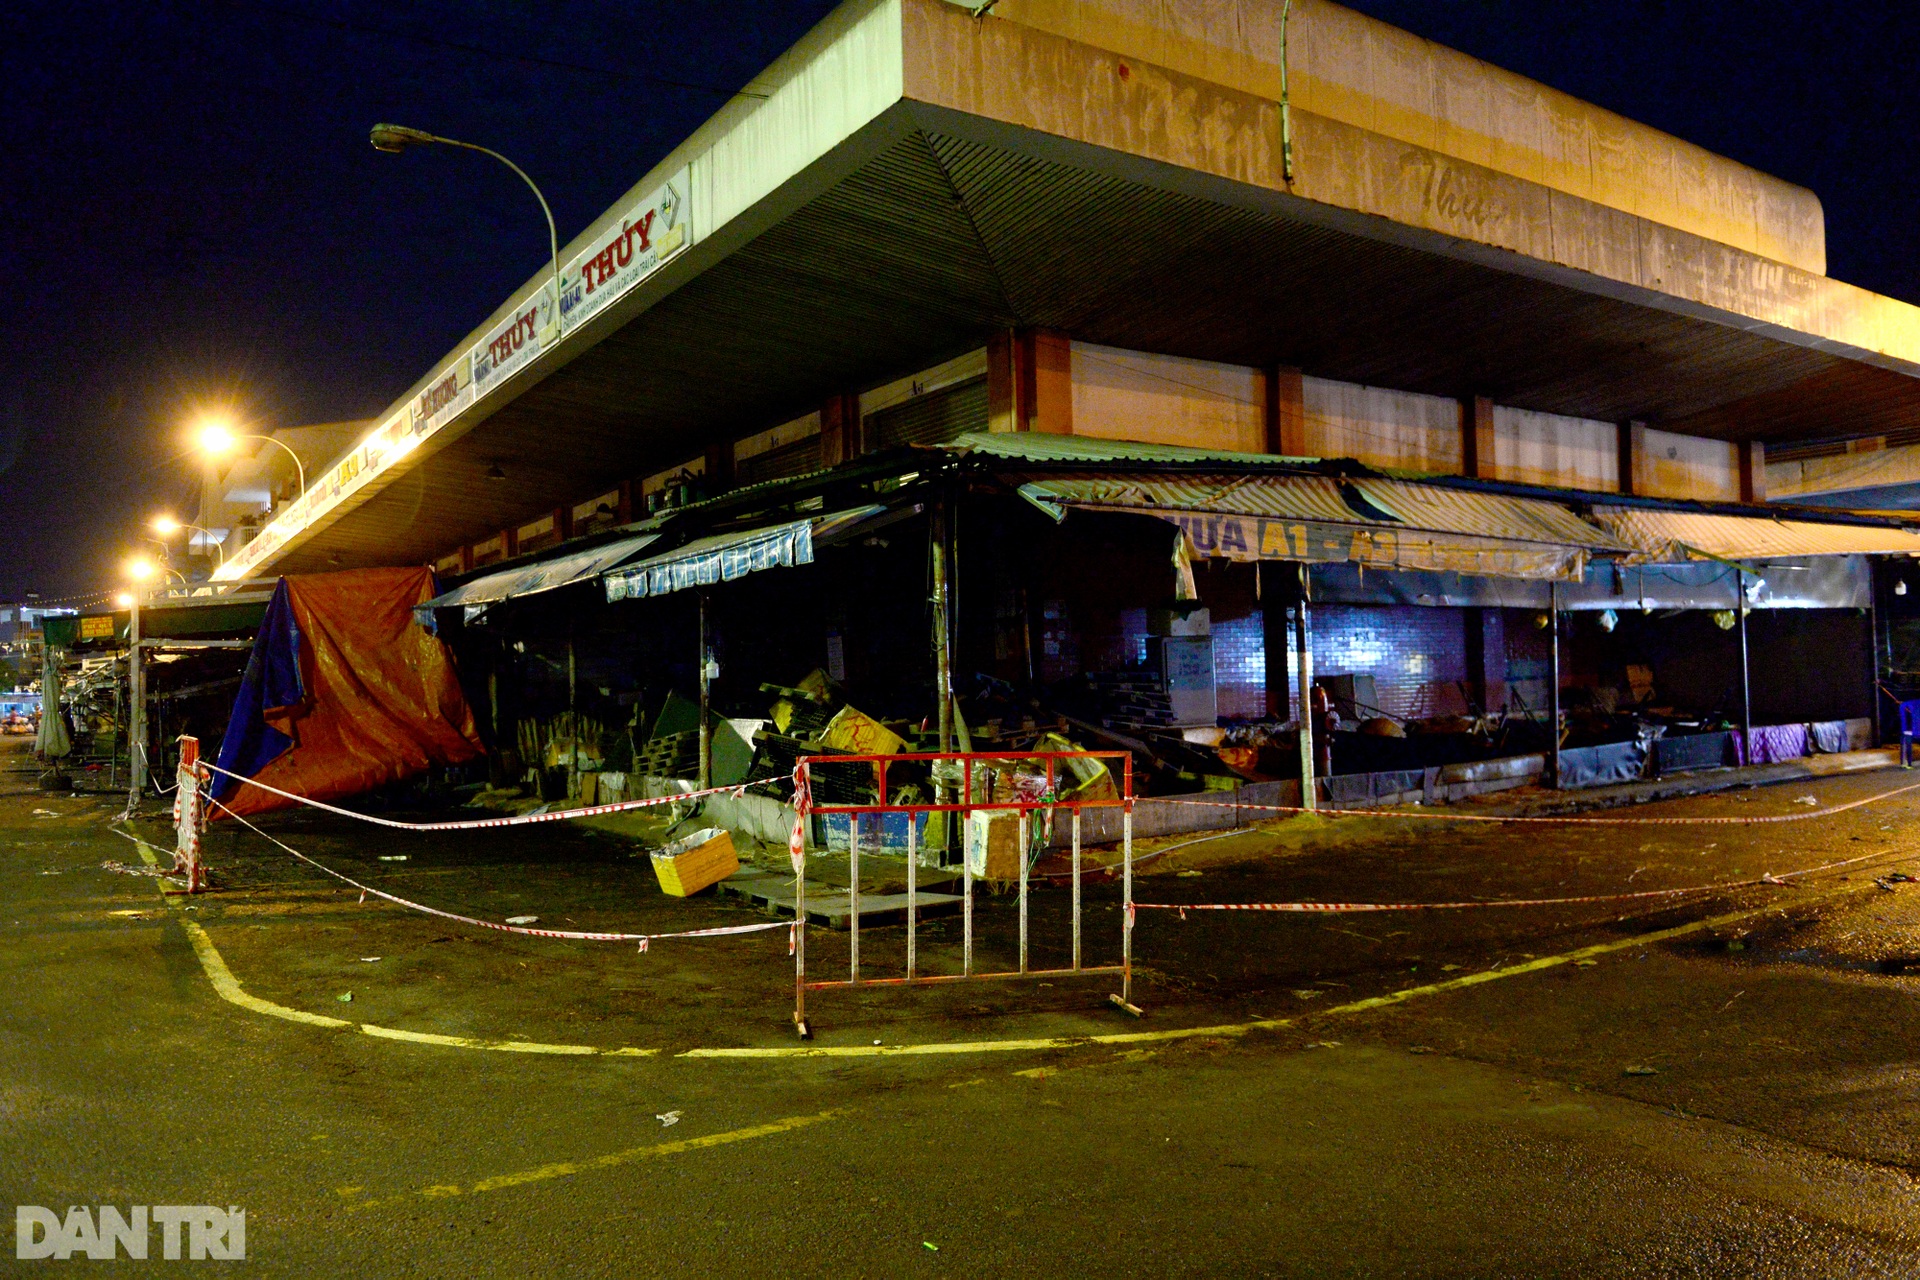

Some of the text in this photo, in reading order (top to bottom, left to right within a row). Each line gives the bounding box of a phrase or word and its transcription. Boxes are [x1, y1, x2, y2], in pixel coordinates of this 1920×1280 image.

[582, 208, 655, 294] THÚY
[489, 306, 537, 368] THÚY
[1164, 515, 1248, 559] VỰA
[1260, 522, 1308, 556] A1
[1351, 530, 1398, 563] A3
